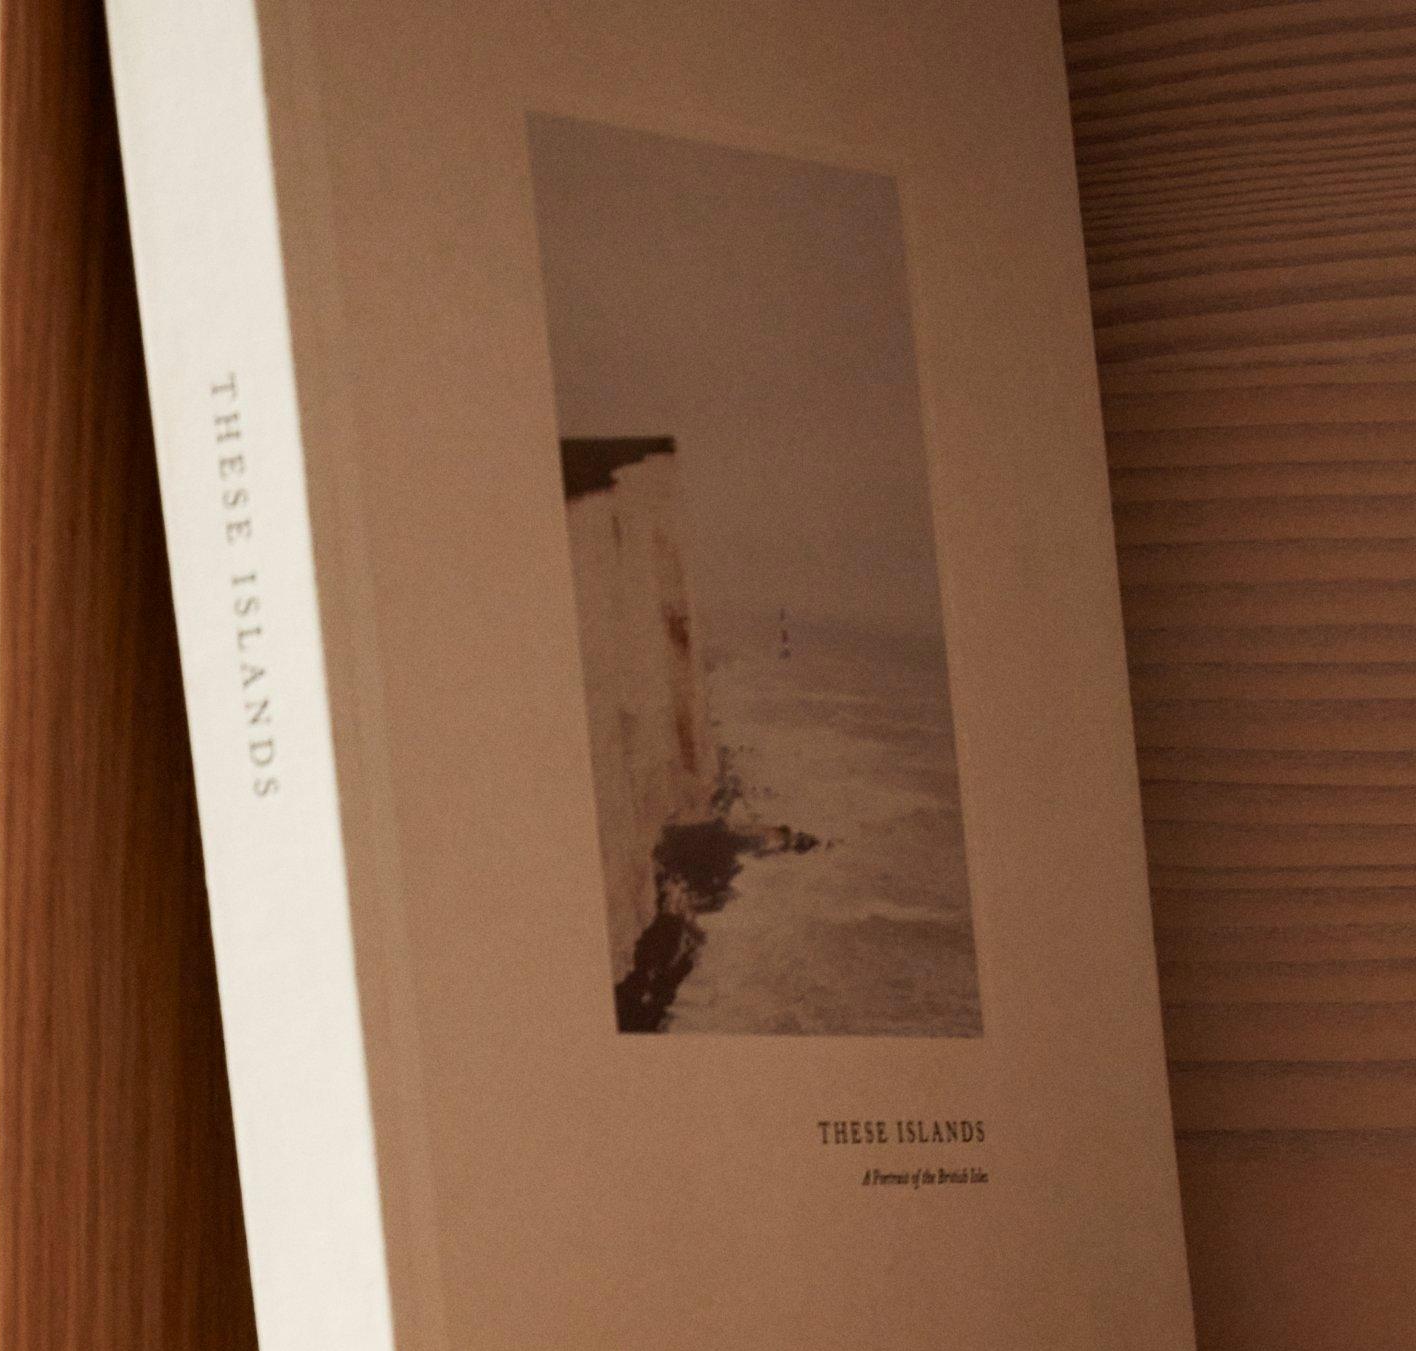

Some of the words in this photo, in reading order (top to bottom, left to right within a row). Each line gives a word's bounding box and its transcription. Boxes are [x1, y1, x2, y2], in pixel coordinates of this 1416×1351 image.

[212, 372, 251, 544] THESE
[232, 571, 279, 798] ISLANDS
[818, 1120, 888, 1145] THESE
[896, 1119, 985, 1143] ISLANDS
